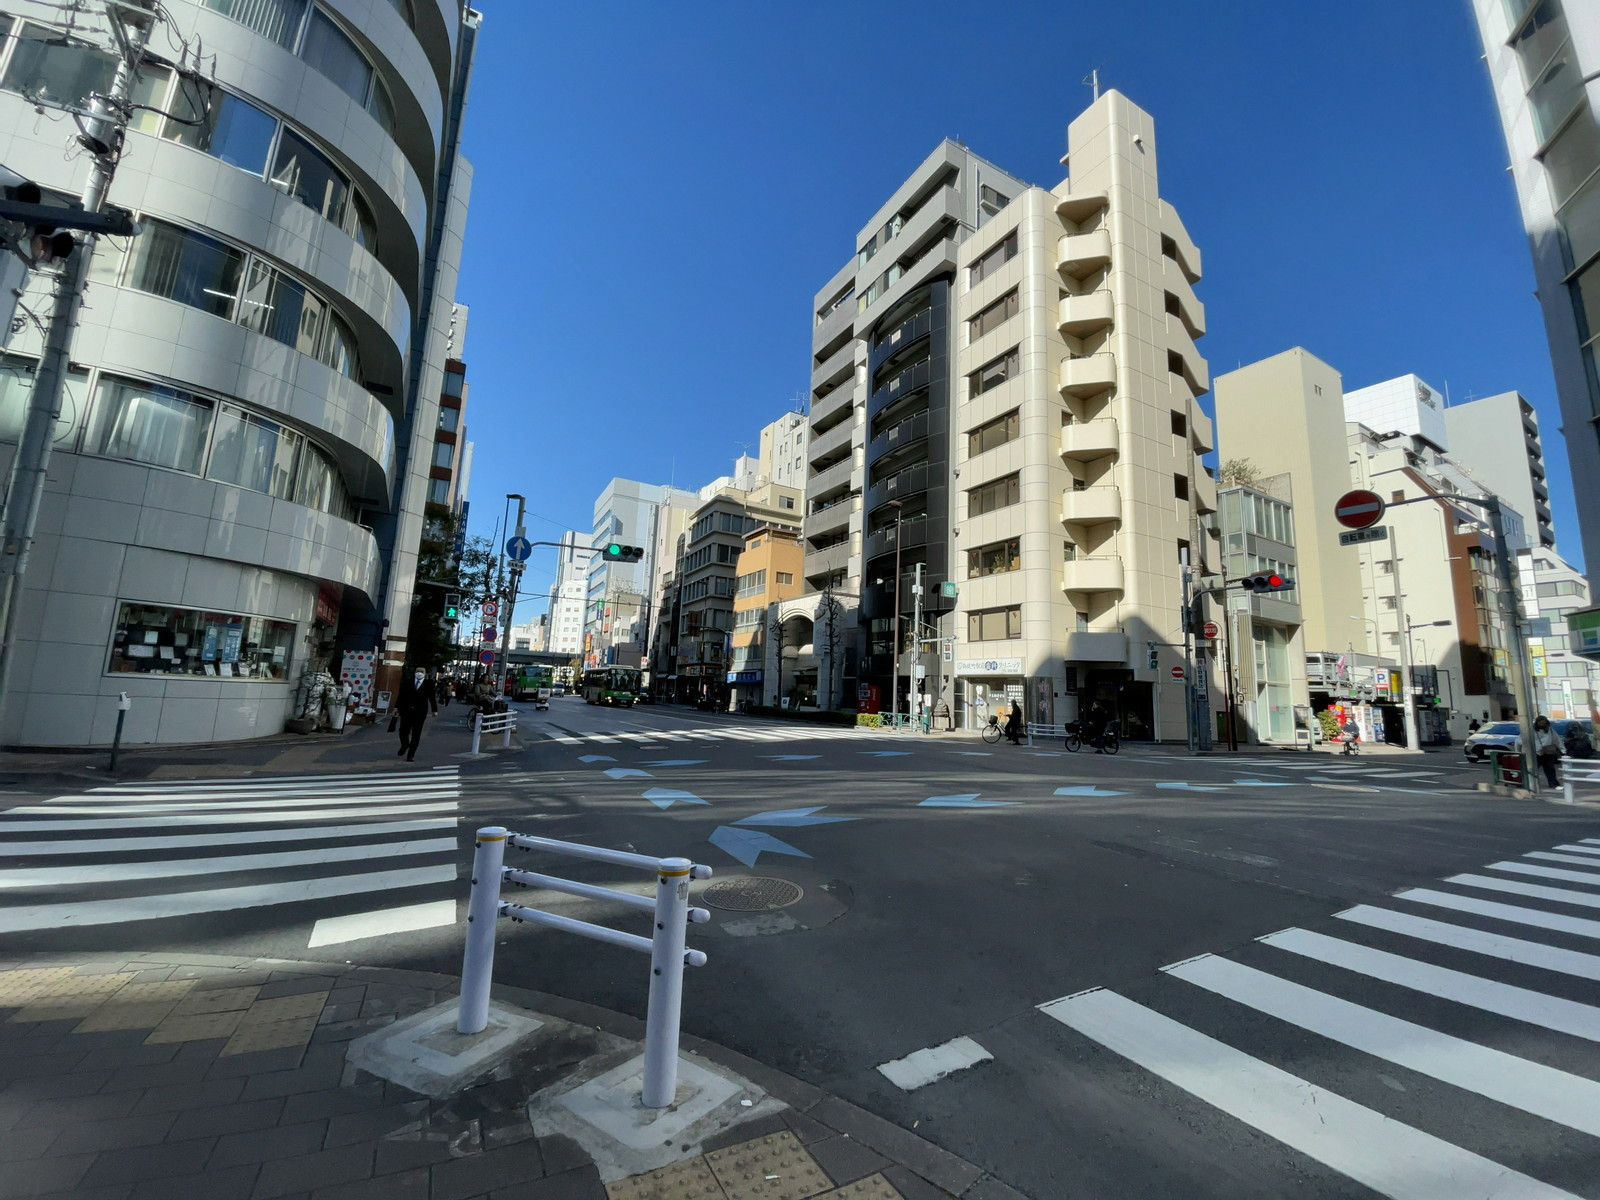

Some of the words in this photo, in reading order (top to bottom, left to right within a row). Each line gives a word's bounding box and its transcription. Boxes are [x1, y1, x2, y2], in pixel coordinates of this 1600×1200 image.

[1341, 530, 1385, 543] 自転車を除く
[1377, 673, 1385, 684] P
